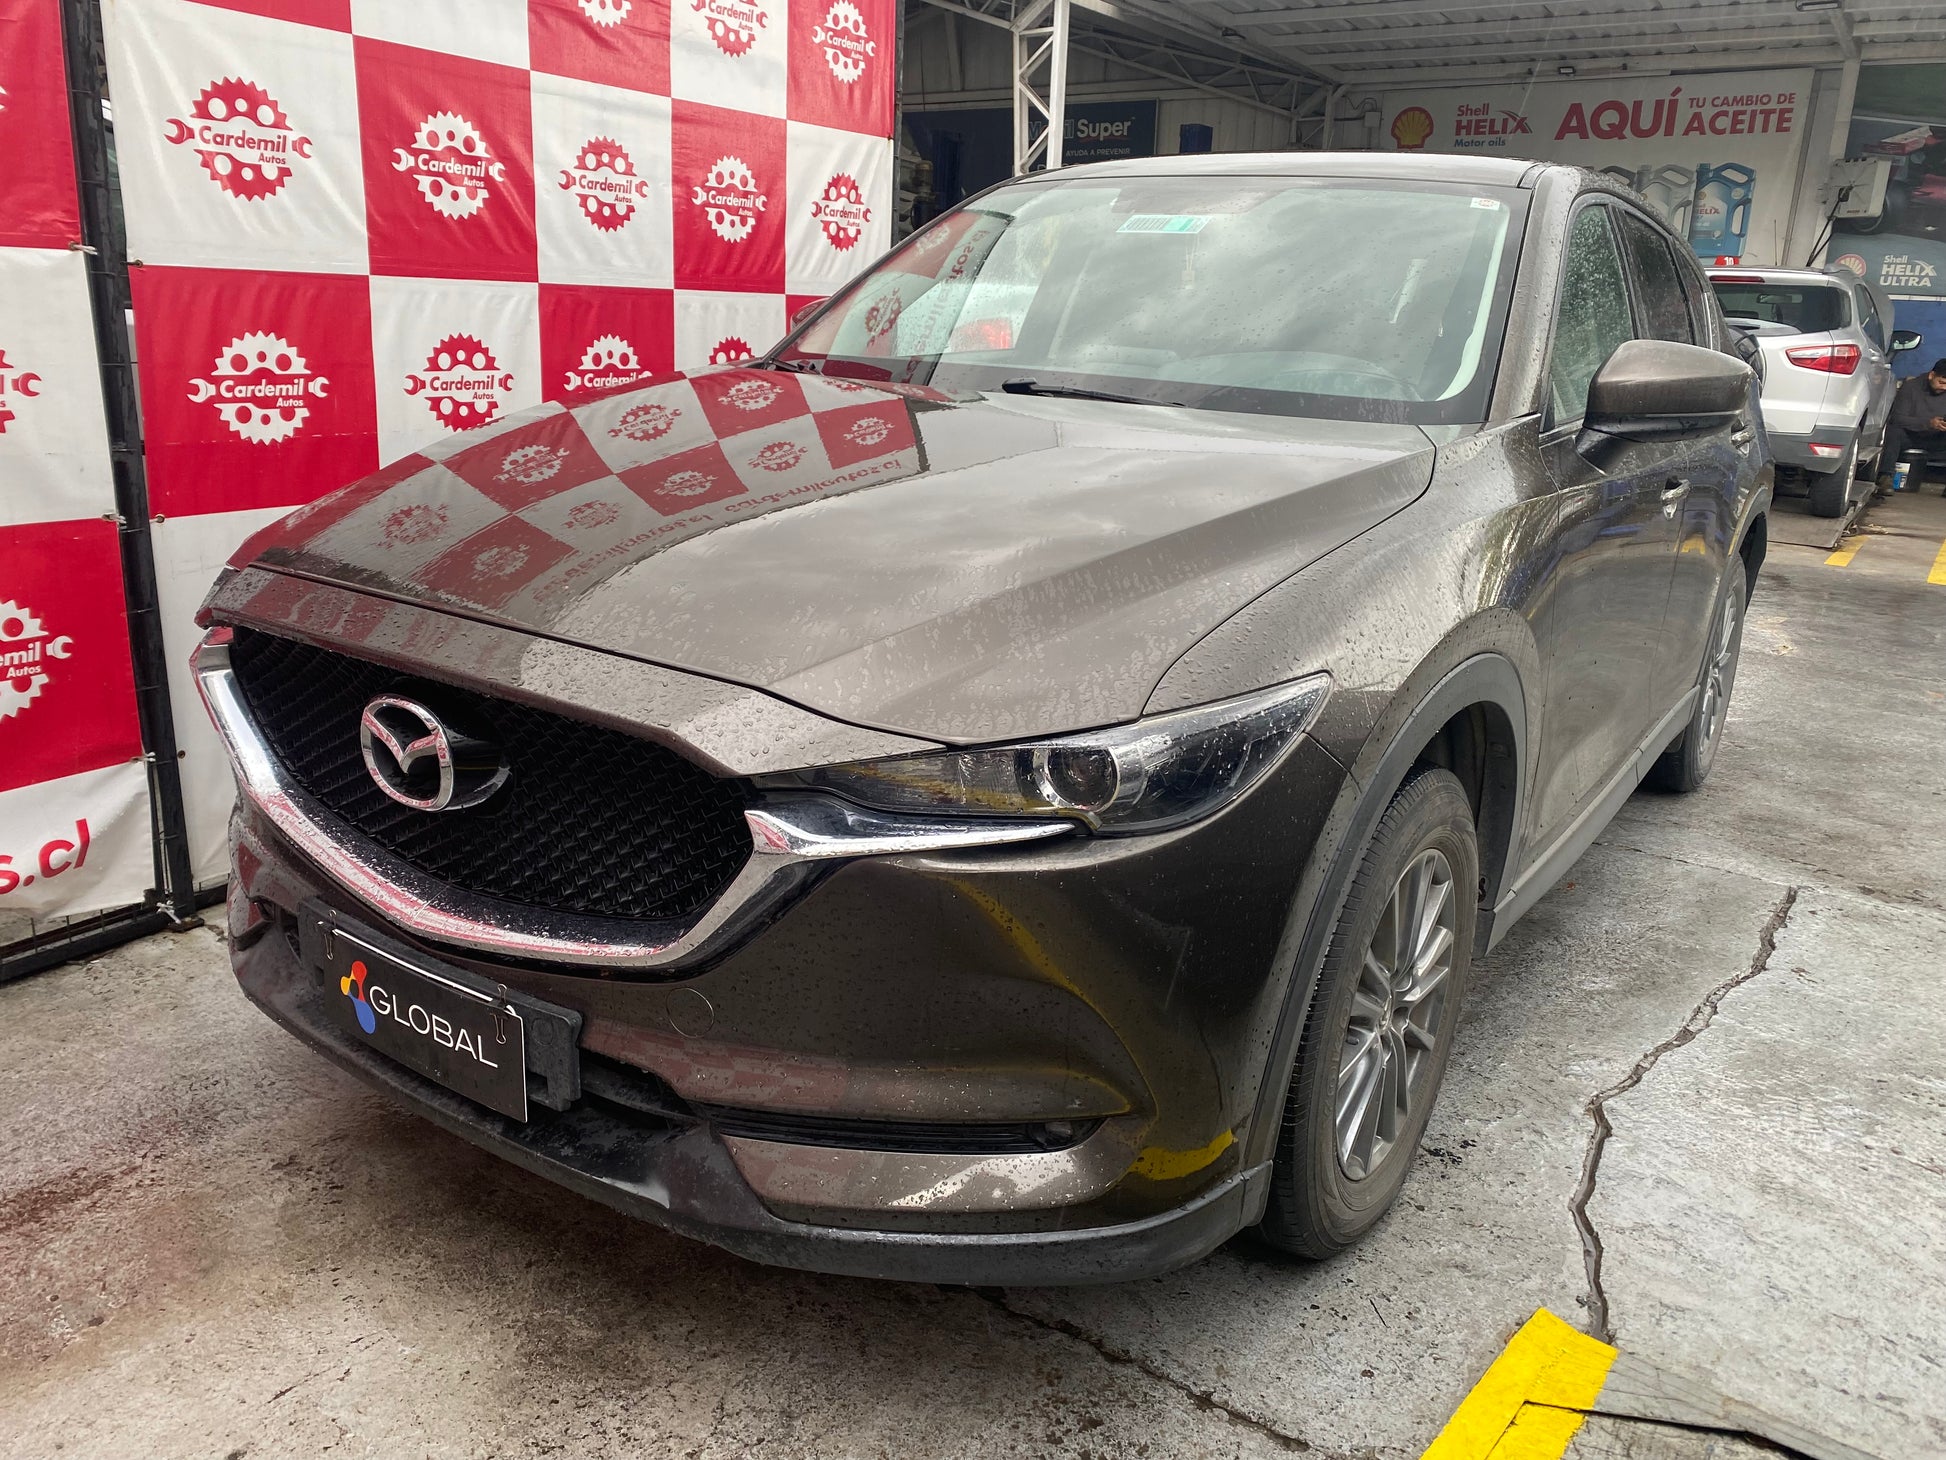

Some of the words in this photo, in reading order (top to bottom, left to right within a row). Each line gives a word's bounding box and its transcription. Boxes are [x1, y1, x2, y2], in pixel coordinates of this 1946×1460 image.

[708, 0, 753, 23] Cardemil
[826, 30, 864, 52] Cardemil
[1689, 97, 1706, 109] TU
[1711, 94, 1772, 108] CAMBIO
[1777, 92, 1796, 105] DE
[1457, 103, 1490, 117] Shell
[1554, 86, 1682, 140] AQUÍ
[1077, 119, 1131, 141] Super
[1455, 112, 1532, 136] HELIX
[1682, 107, 1794, 136] ACEITE
[199, 128, 287, 154] Cardemil
[1454, 138, 1485, 147] Motor
[1488, 137, 1506, 147] oils
[258, 152, 286, 165] Autos
[1066, 149, 1088, 157] AYUDA
[1097, 147, 1131, 156] PREVENIR
[417, 153, 485, 178] Cardemil
[463, 177, 485, 188] Autos
[578, 175, 632, 195] Cardemil
[614, 194, 632, 204] Autos
[708, 189, 753, 208] Cardemil
[823, 203, 860, 221] Cardemil
[1881, 260, 1937, 276] HELIX
[1884, 255, 1908, 264] Shell
[1880, 276, 1932, 287] ULTRA
[219, 378, 304, 399] Cardemil
[428, 375, 494, 392] Cardemil
[276, 397, 304, 408] Autos
[472, 391, 495, 400] Autos
[6, 666, 41, 679] Autos
[369, 985, 498, 1068] GLOBAL
